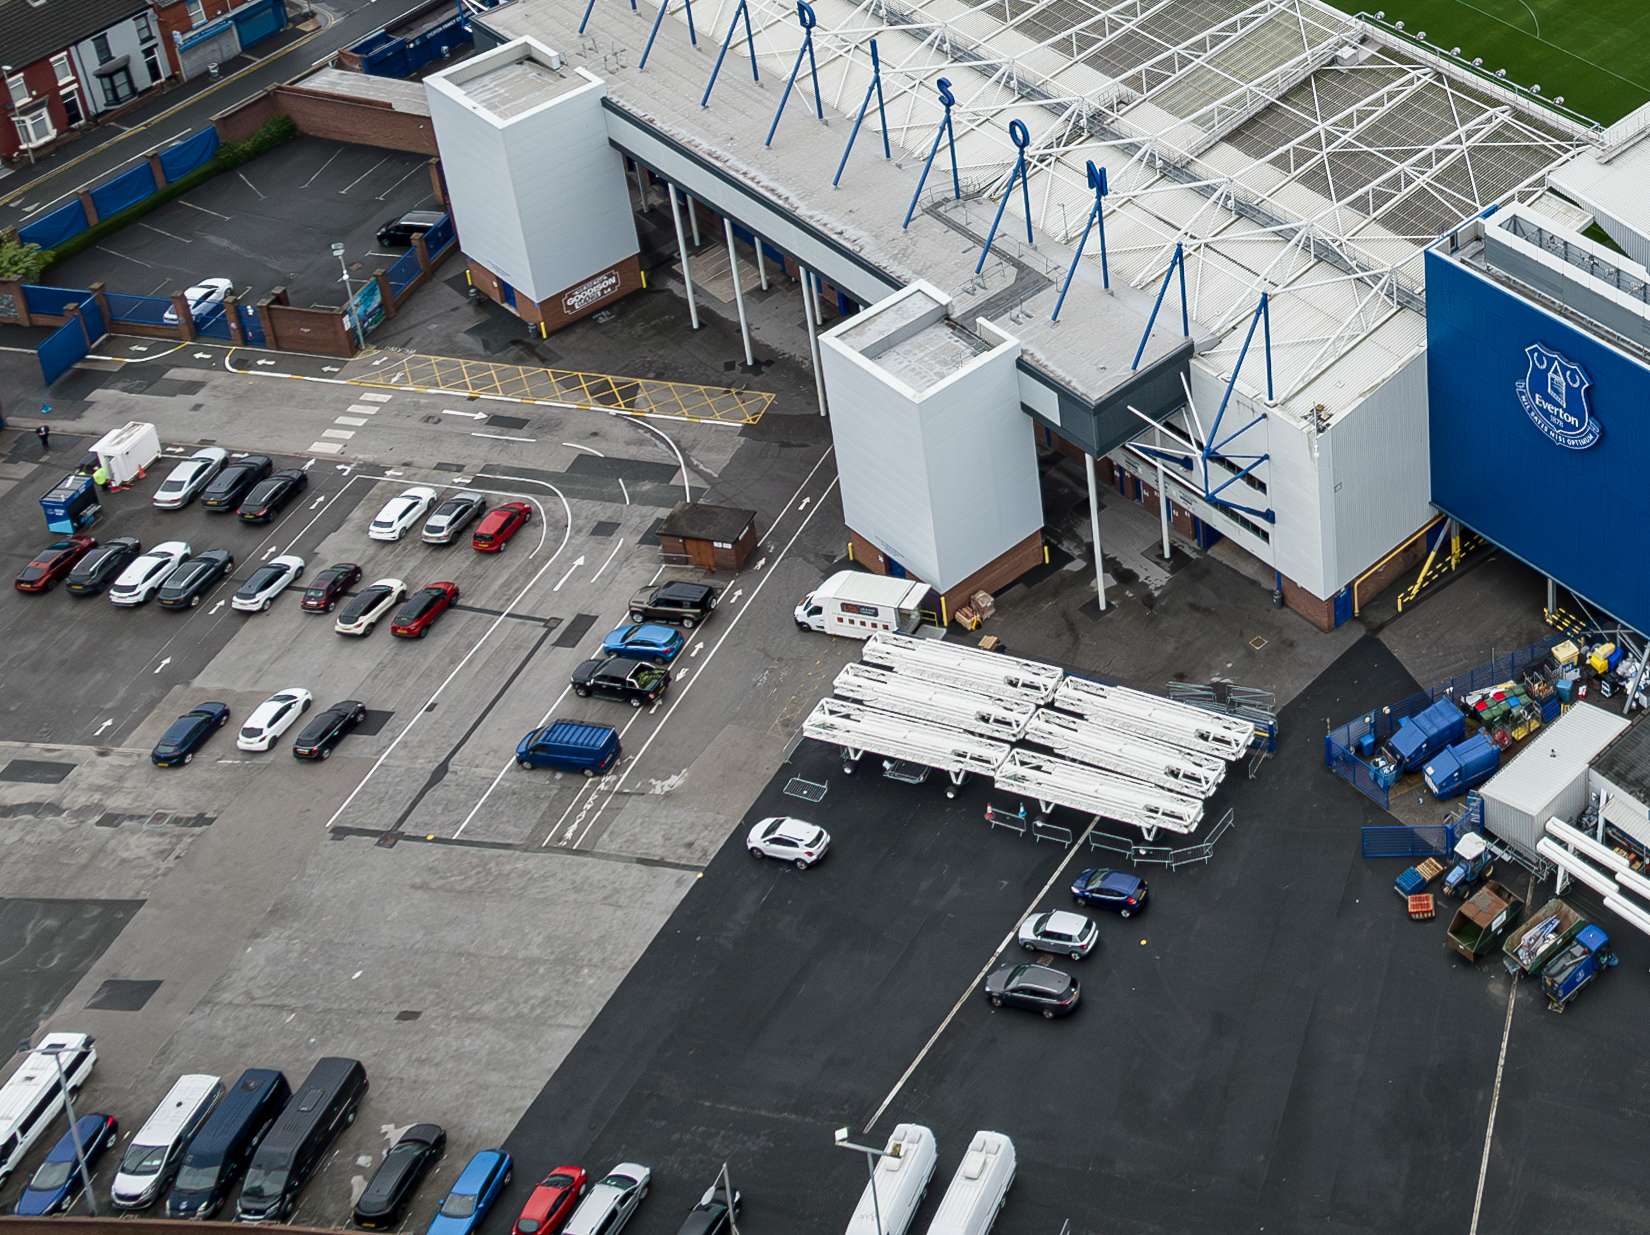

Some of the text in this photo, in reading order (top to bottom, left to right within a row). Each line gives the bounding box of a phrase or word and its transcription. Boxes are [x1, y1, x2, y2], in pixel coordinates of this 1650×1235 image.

[566, 276, 616, 306] GOODISON
[1535, 393, 1579, 427] Everton
[1531, 412, 1548, 432] SATIS
[1550, 432, 1566, 444] NISI
[1567, 433, 1594, 446] OPTIMUM
